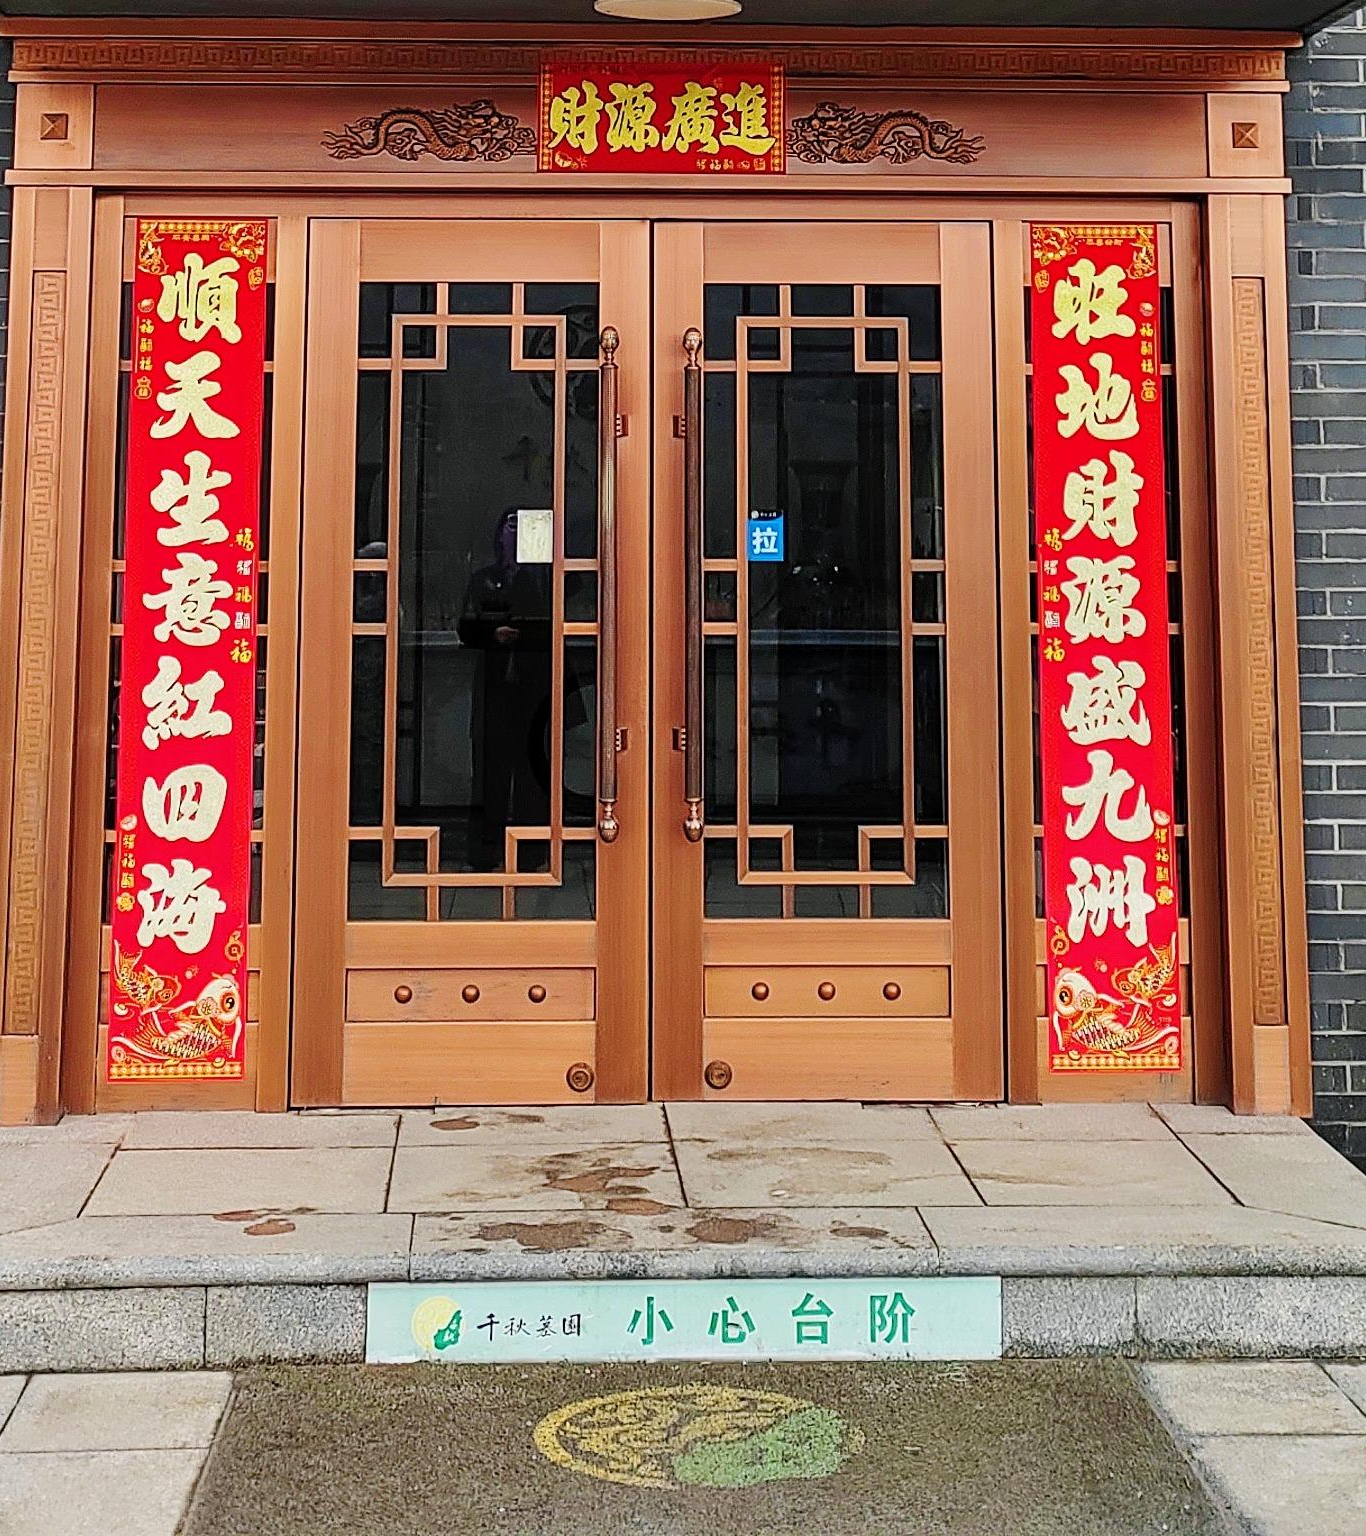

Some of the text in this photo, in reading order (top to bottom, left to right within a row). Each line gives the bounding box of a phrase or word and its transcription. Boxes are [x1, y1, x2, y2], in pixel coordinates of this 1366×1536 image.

[547, 80, 777, 155] 財源廣進
[752, 527, 778, 555] 拉
[137, 252, 242, 954] 順天生意紅四海
[627, 1292, 915, 1346] 小心台阶
